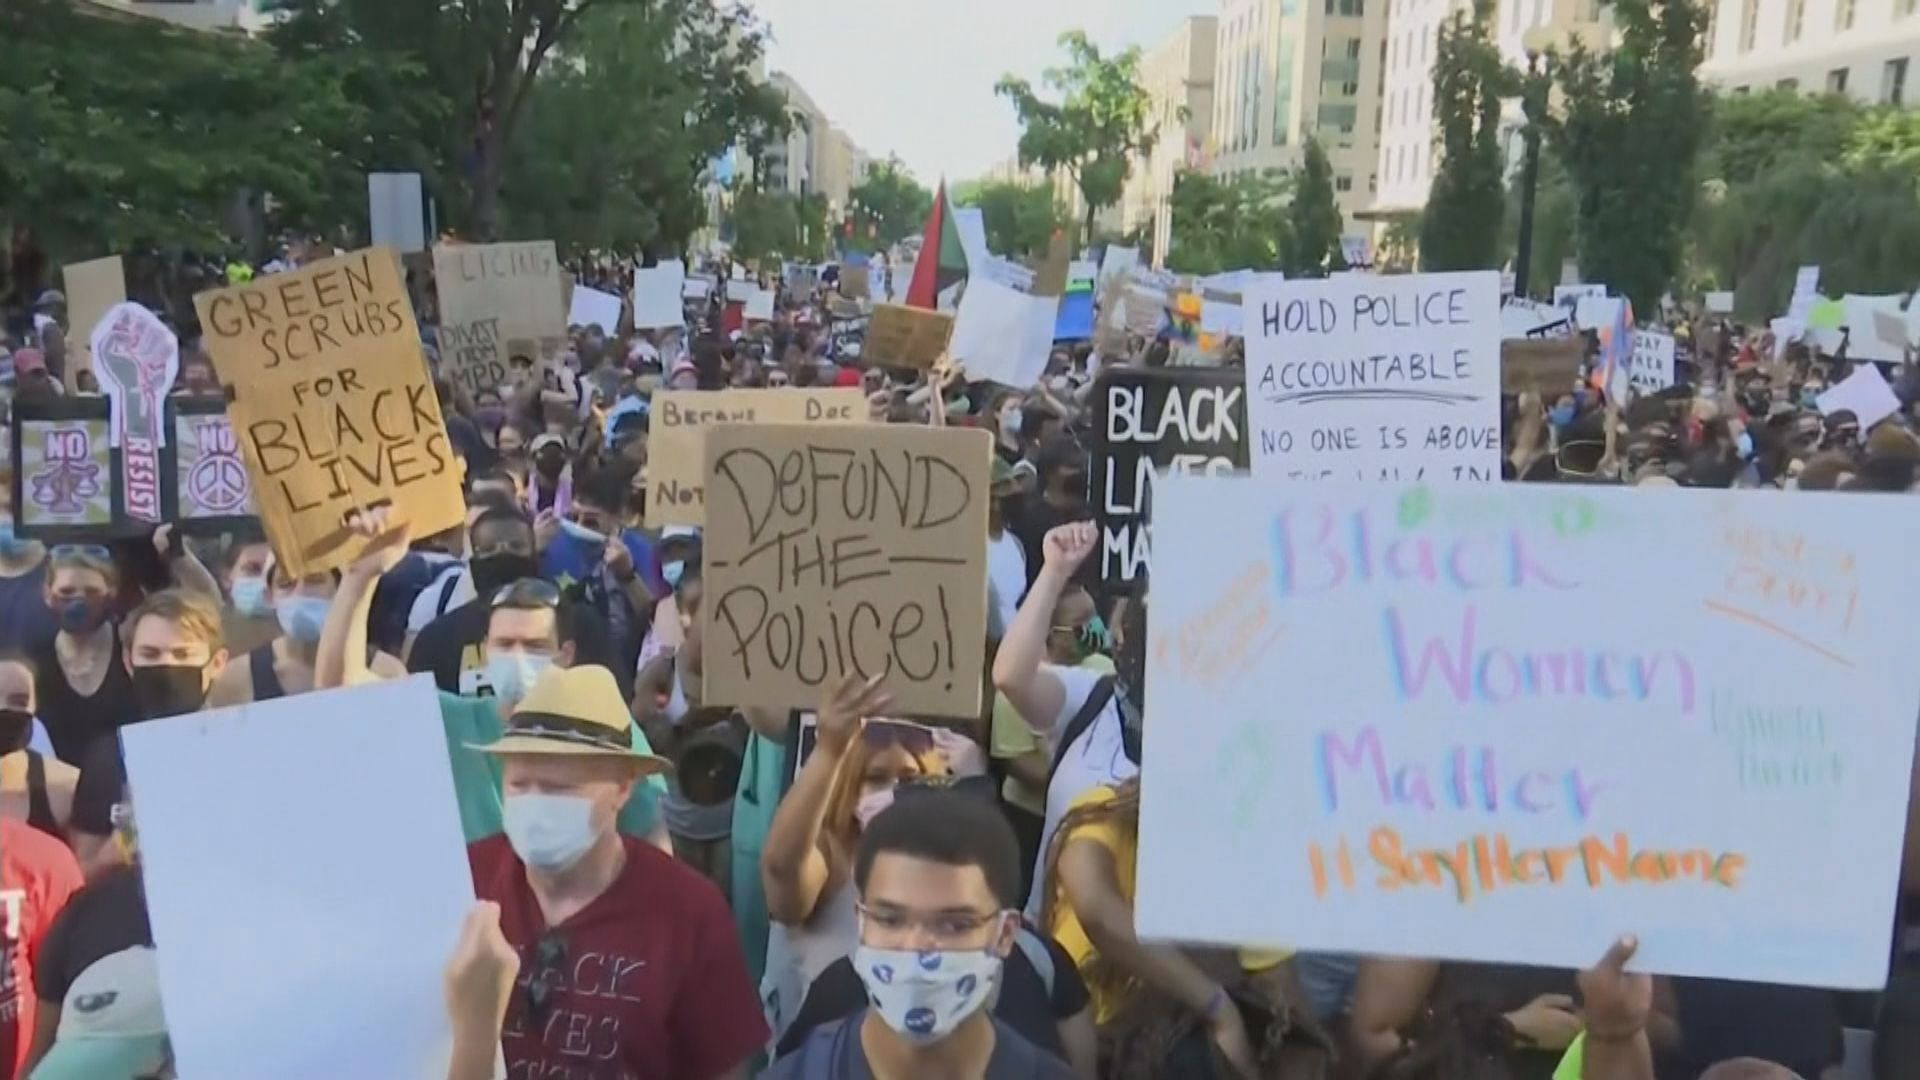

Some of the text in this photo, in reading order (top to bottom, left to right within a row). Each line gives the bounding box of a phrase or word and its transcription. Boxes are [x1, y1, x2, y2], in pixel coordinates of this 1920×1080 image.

[209, 254, 374, 337] GREEN
[1262, 288, 1471, 337] HOLD POLICE
[292, 367, 365, 407] FOR
[1257, 348, 1473, 390] ACCOUNTABLE
[46, 430, 88, 462] NO
[248, 383, 441, 476] BLACK
[1107, 385, 1242, 443] BLACK
[1261, 425, 1500, 455] NO ONE IS ABOVE
[127, 436, 157, 522] RESIST
[279, 432, 446, 514] LIVES
[1271, 504, 1580, 597] Black
[1382, 603, 1695, 713] Women
[1314, 724, 1614, 822] Matter
